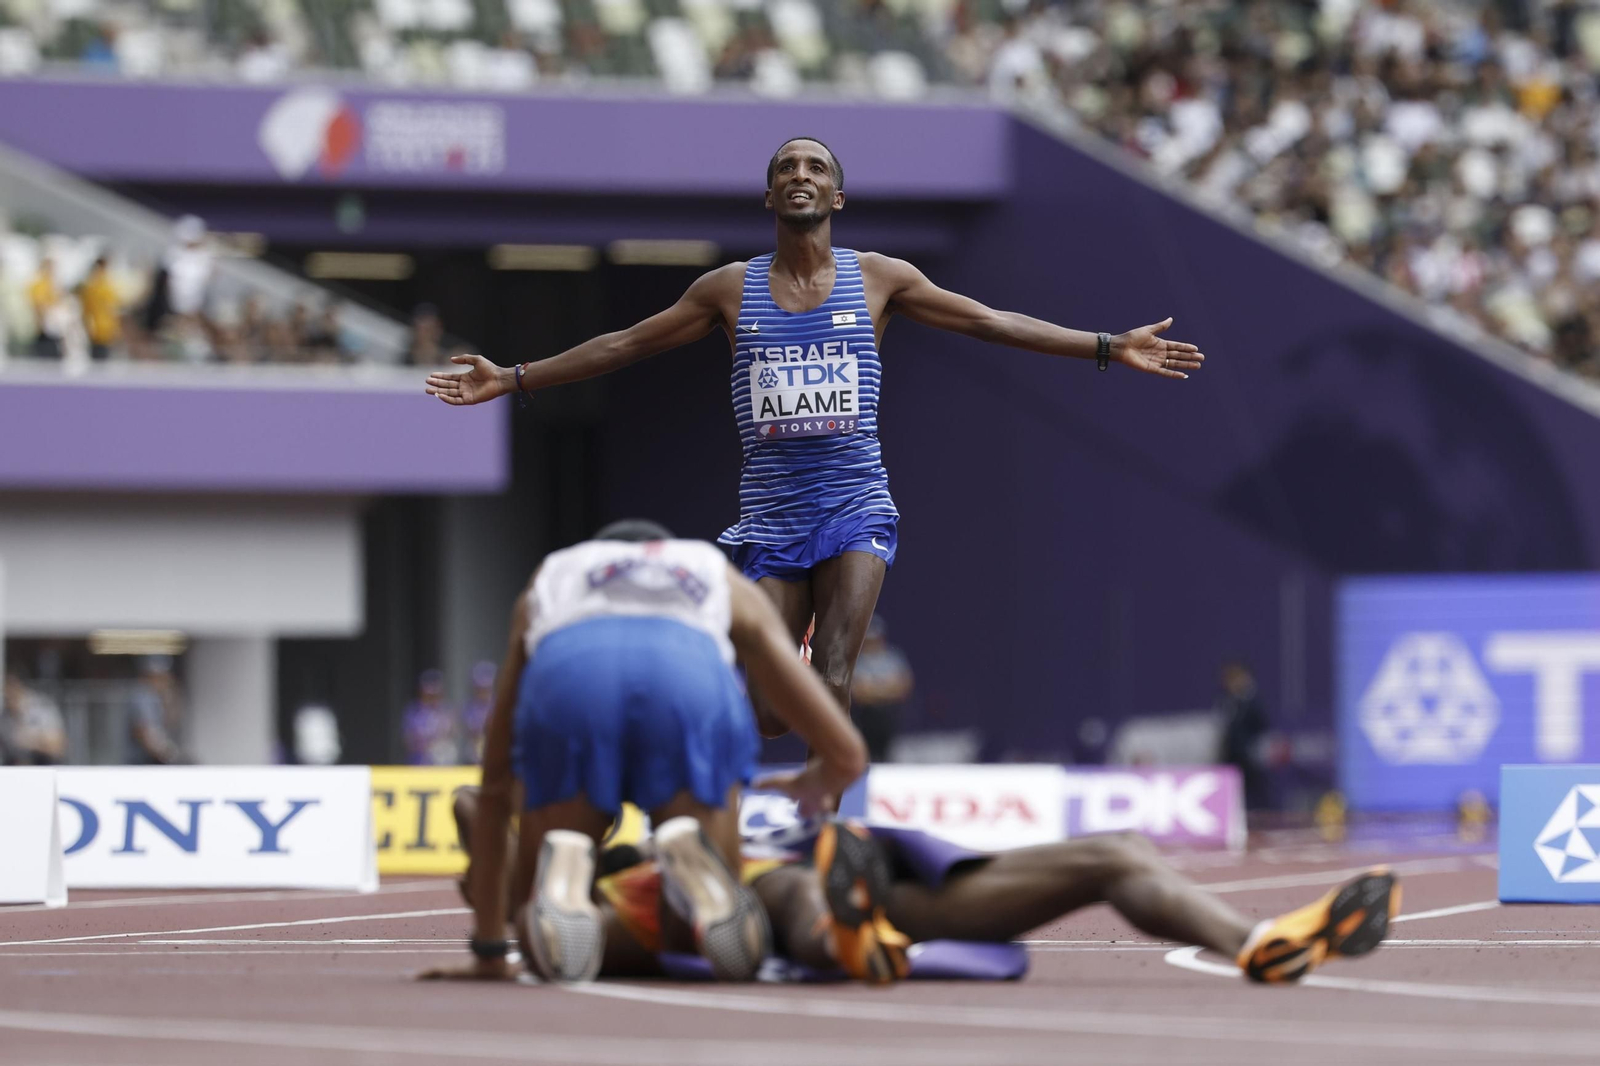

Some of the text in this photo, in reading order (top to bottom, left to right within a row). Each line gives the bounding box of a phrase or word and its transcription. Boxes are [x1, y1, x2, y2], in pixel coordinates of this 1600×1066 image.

[748, 341, 857, 364] ISRAEL
[778, 362, 850, 387] TDK
[759, 390, 852, 419] ALAME
